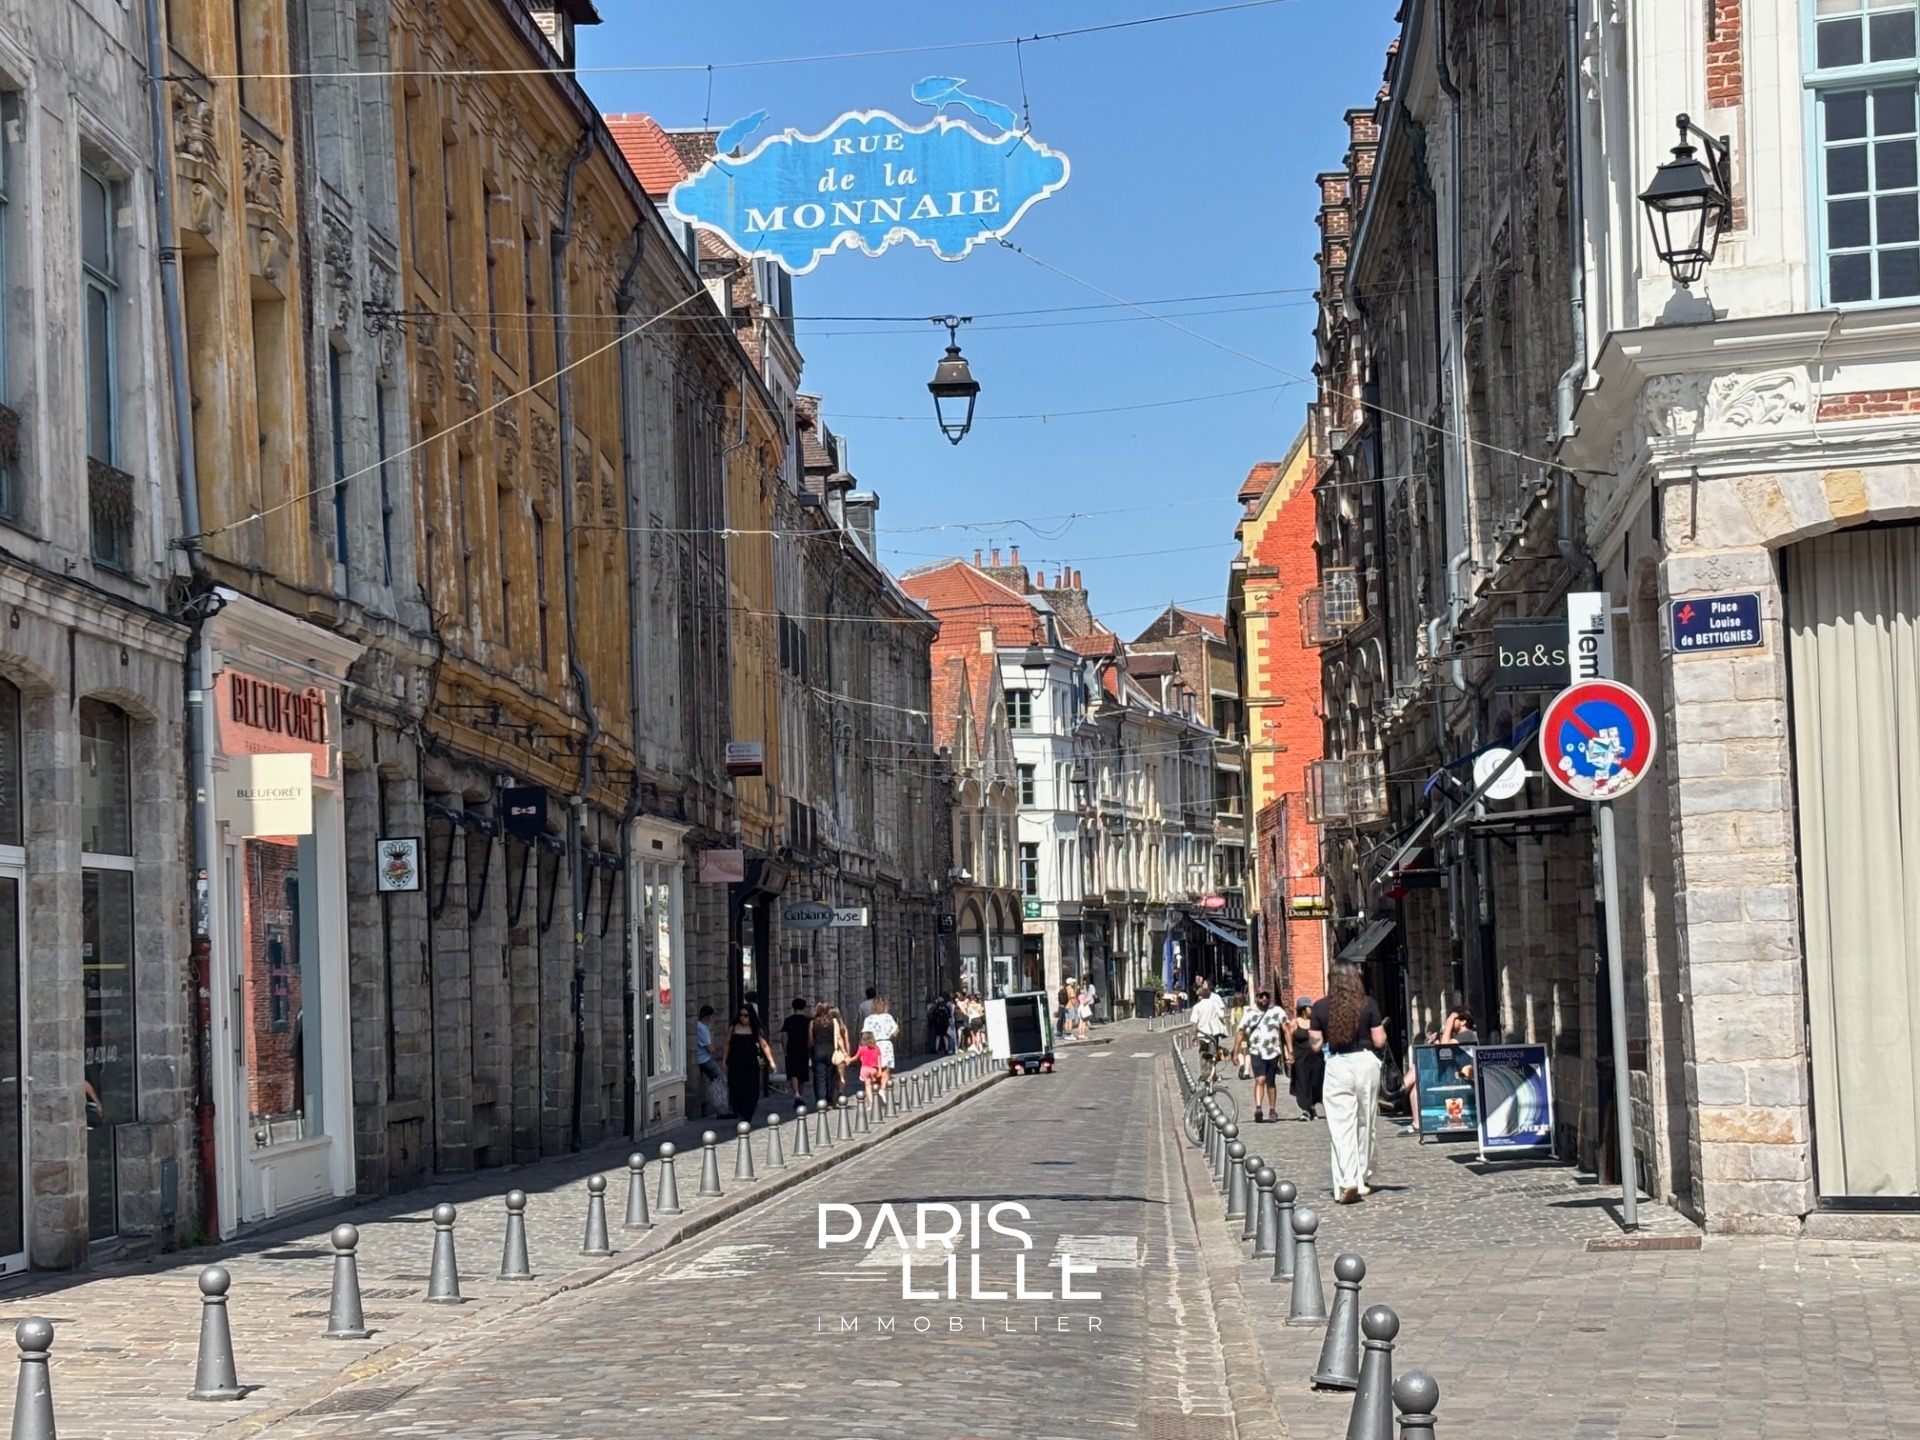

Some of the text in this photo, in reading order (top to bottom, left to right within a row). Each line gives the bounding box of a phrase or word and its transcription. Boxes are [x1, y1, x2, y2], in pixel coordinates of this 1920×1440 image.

[832, 132, 905, 156] RUE
[818, 163, 917, 193] de la
[743, 188, 1001, 233] MONNAIE
[1711, 602, 1738, 613] Place
[1709, 616, 1741, 629] Louise
[1681, 629, 1753, 647] de BETTIGNIES
[1499, 644, 1570, 667] ba&s
[1578, 629, 1605, 680] lem
[231, 673, 328, 745] BLEUFORÊT
[236, 786, 303, 798] BLEUFORÊT
